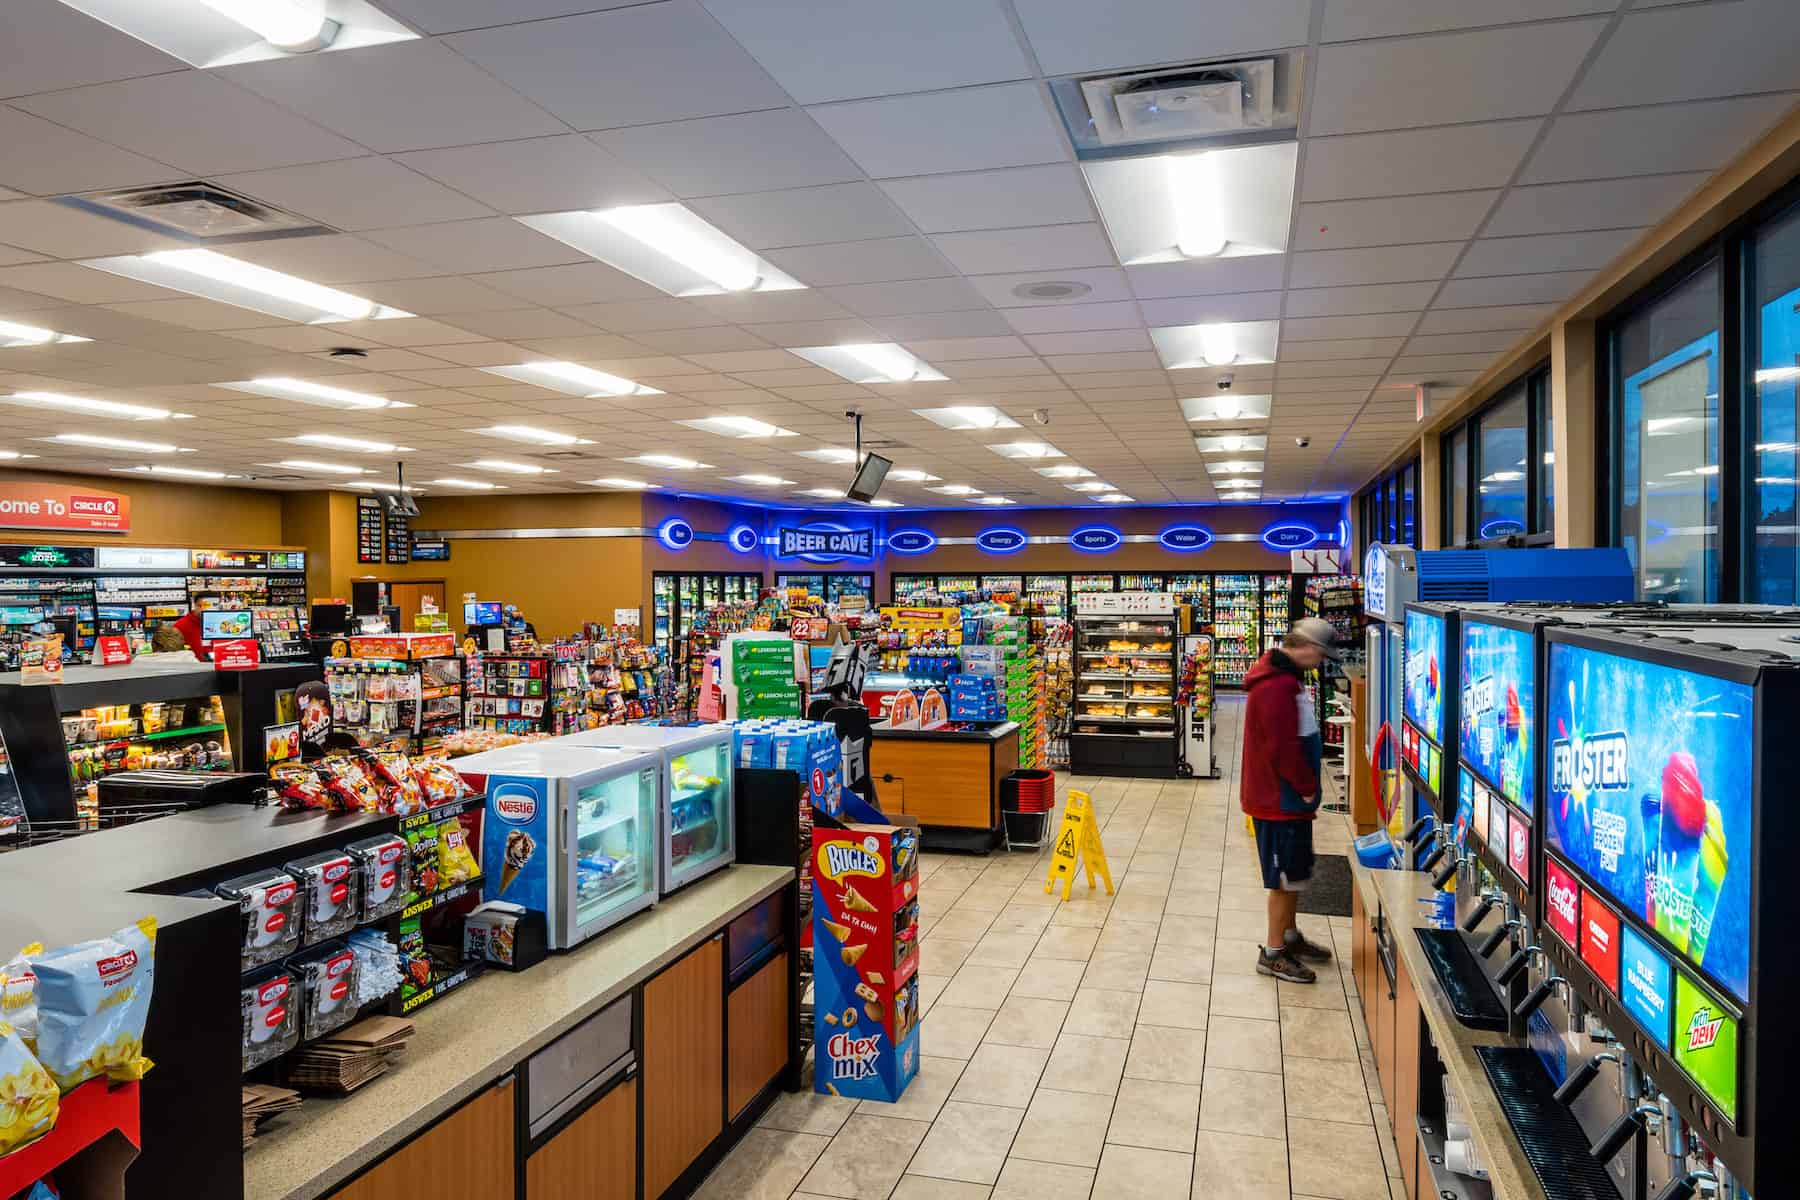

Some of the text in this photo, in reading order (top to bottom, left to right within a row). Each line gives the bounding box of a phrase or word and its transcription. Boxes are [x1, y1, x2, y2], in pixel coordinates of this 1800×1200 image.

[44, 499, 65, 515] To
[73, 501, 116, 514] CIRCLE K
[784, 531, 869, 552] BEER CAVE
[990, 536, 1012, 545] Energy
[1084, 535, 1106, 543] Sports
[795, 623, 809, 635] 22
[1554, 734, 1628, 789] FROSTER
[1594, 830, 1624, 851] FROZEN
[826, 844, 878, 876] BUGLES
[403, 898, 433, 919] ANSWER
[1637, 959, 1655, 985] BLUE
[402, 987, 434, 1013] ANSWER
[1627, 967, 1665, 1013] RASPBERRY
[828, 1033, 880, 1057] Chex
